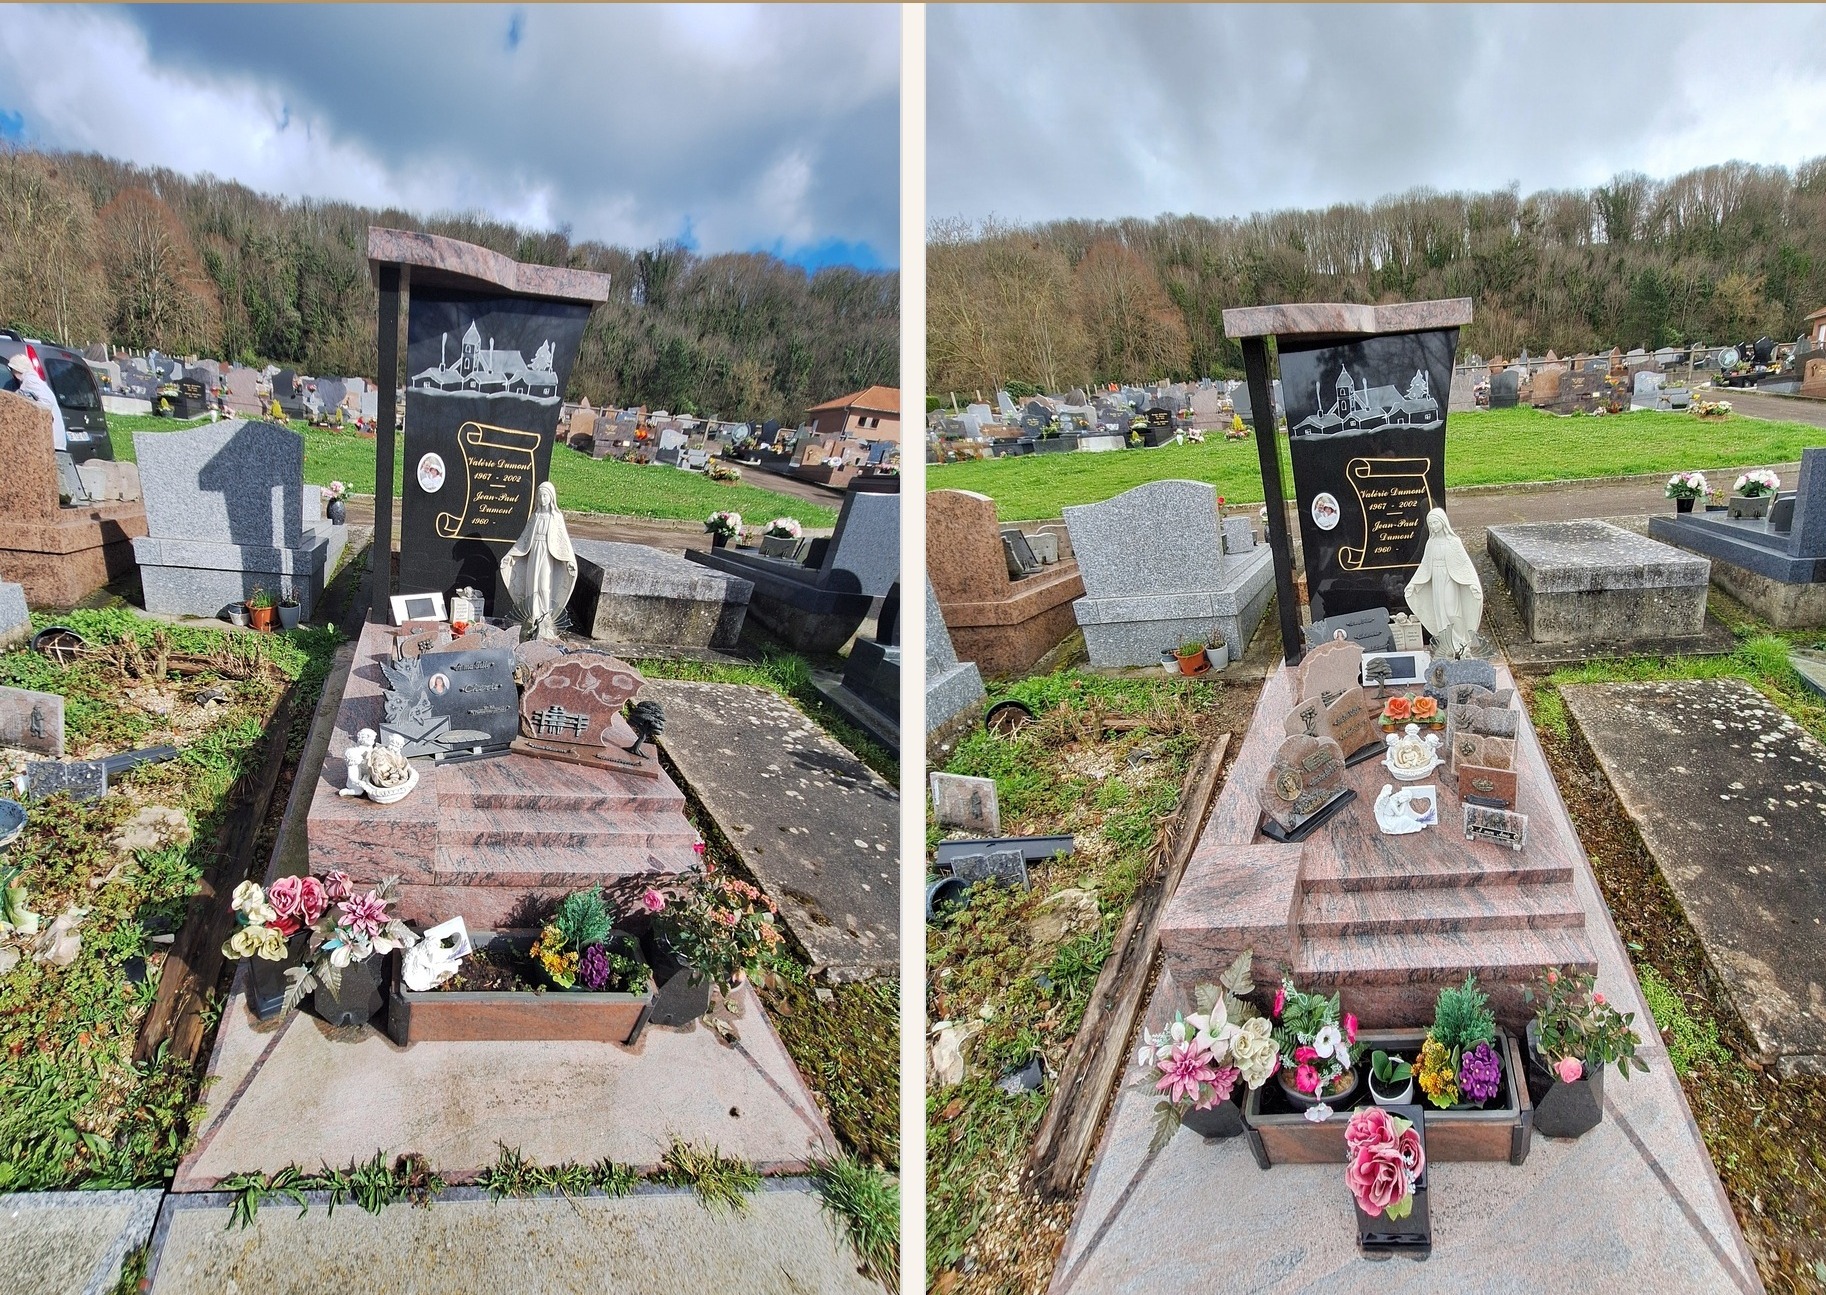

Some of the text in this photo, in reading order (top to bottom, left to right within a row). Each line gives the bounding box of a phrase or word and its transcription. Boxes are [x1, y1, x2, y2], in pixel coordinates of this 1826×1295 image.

[468, 456, 532, 470] Valérie Dumont
[474, 472, 492, 480] 1967
[502, 474, 522, 482] 2002
[472, 491, 519, 502] Jean-Paul
[1360, 486, 1426, 498] Valérie Dumont
[479, 504, 513, 514] Dumont
[1369, 502, 1387, 510] 1967
[1398, 500, 1418, 508] 2002
[471, 517, 490, 525] 1960
[1371, 518, 1419, 532] Jean-Paul
[1379, 531, 1414, 541] Dumont
[1374, 545, 1392, 553] 1960
